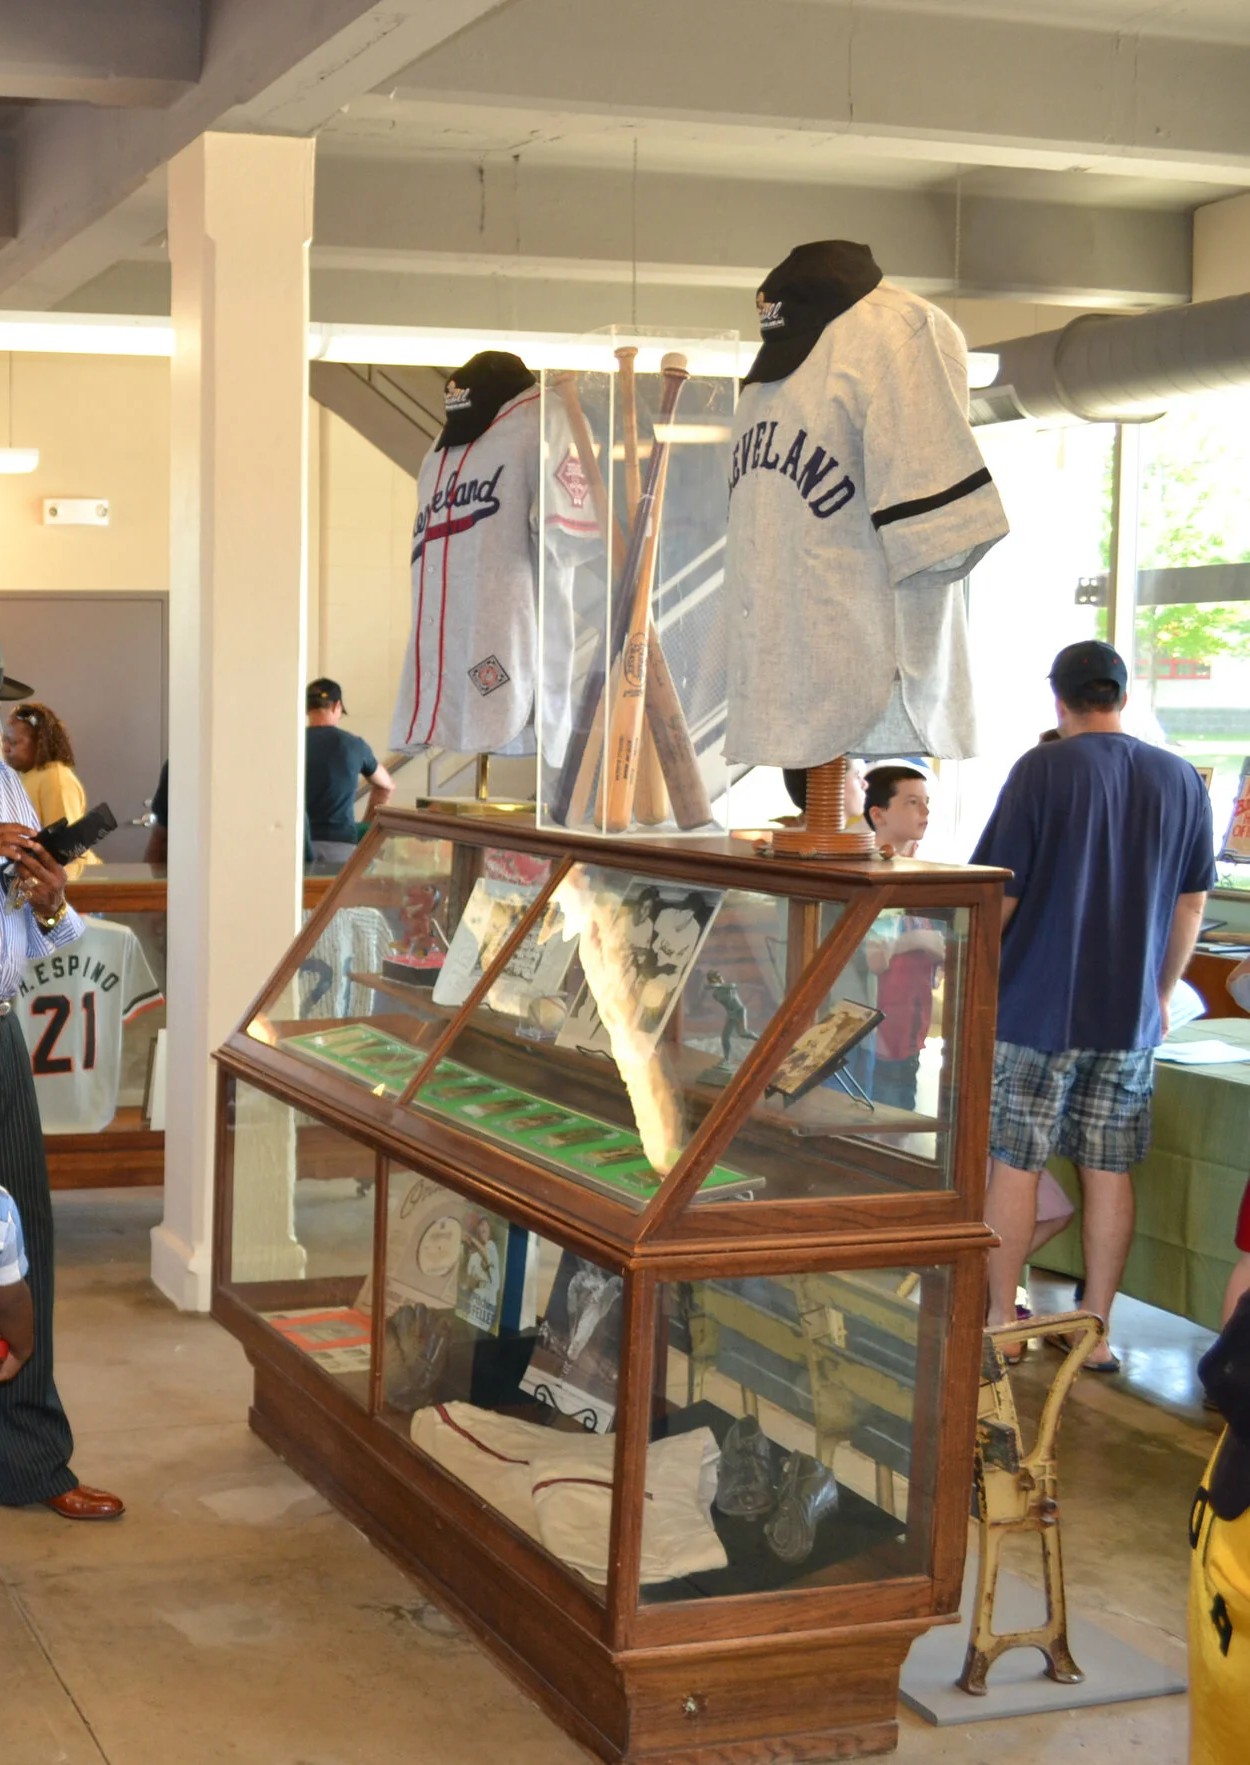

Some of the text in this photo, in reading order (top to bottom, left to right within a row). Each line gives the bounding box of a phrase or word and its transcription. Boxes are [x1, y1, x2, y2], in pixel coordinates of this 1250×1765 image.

[413, 464, 505, 538] eveland
[727, 421, 856, 519] EVELAND
[33, 955, 119, 992] ESPINO
[29, 991, 98, 1077] 21
